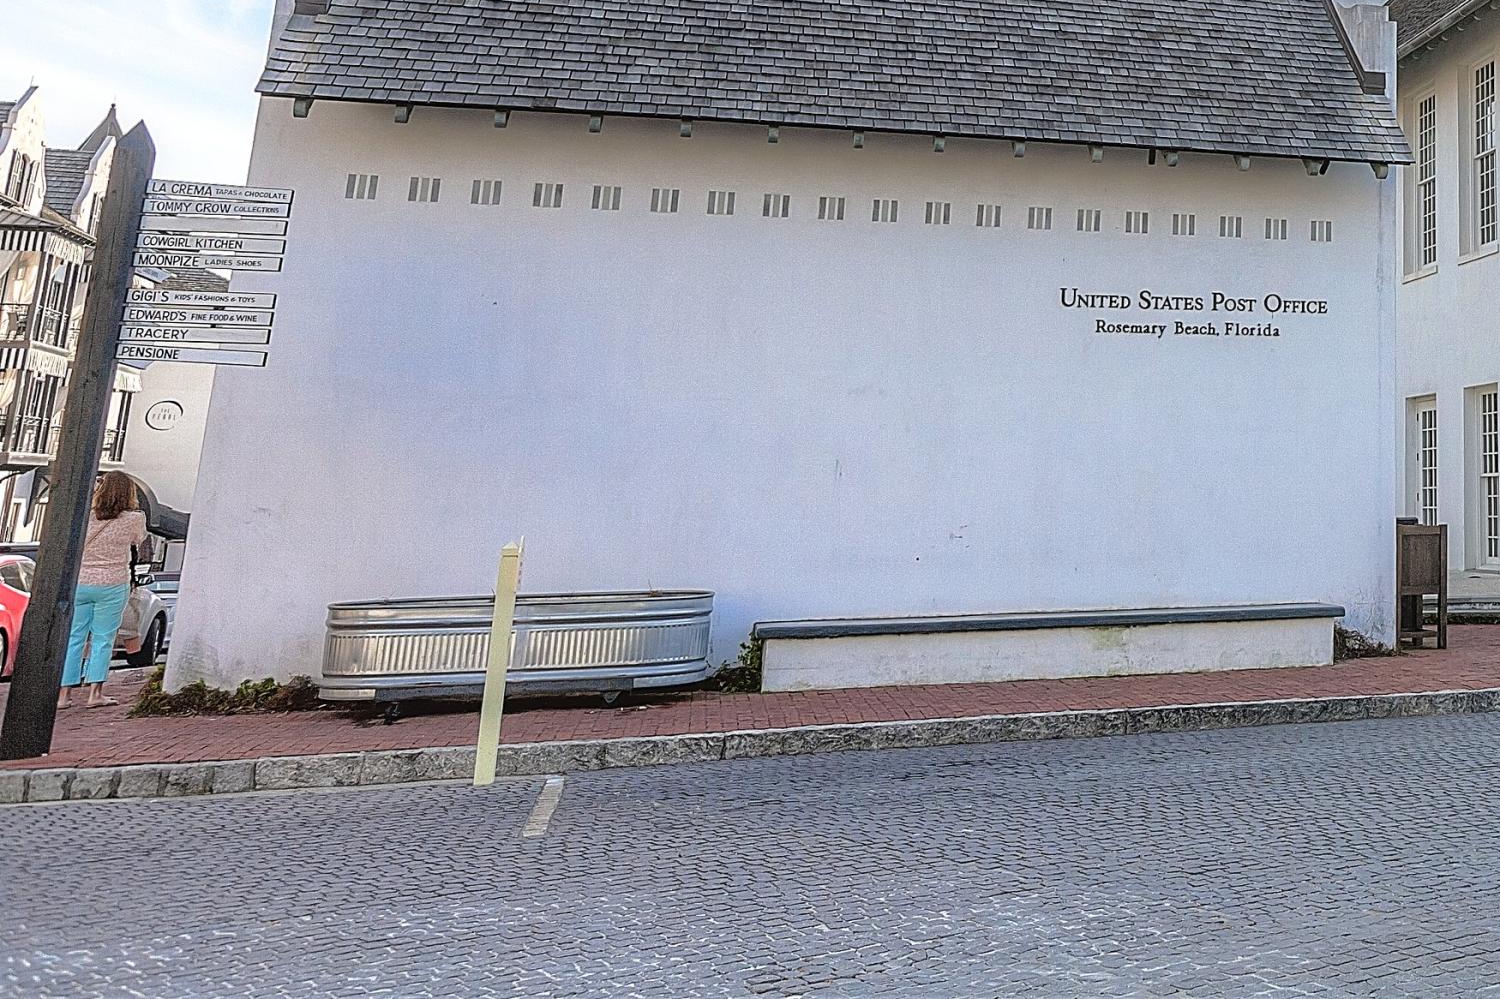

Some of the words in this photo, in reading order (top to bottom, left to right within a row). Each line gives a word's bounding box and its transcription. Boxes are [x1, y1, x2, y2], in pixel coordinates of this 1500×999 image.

[152, 182, 166, 193] LA
[172, 183, 212, 196] CREMA
[244, 190, 288, 199] CHOCOLATE
[150, 201, 192, 212] TOMMY
[195, 203, 231, 213] CROW
[142, 235, 191, 247] COWGIRL
[196, 238, 243, 249] KITCHEN
[138, 255, 199, 266] MOONPIZE
[131, 291, 169, 302] GIGI'S
[129, 309, 187, 321] EDWARD'S
[209, 313, 228, 321] FOOD
[126, 328, 189, 339] TRACERY
[1096, 319, 1166, 337] Rosemary
[1174, 322, 1219, 336] Beach,
[1225, 323, 1280, 336] Florida
[121, 346, 179, 359] PENSIONE
